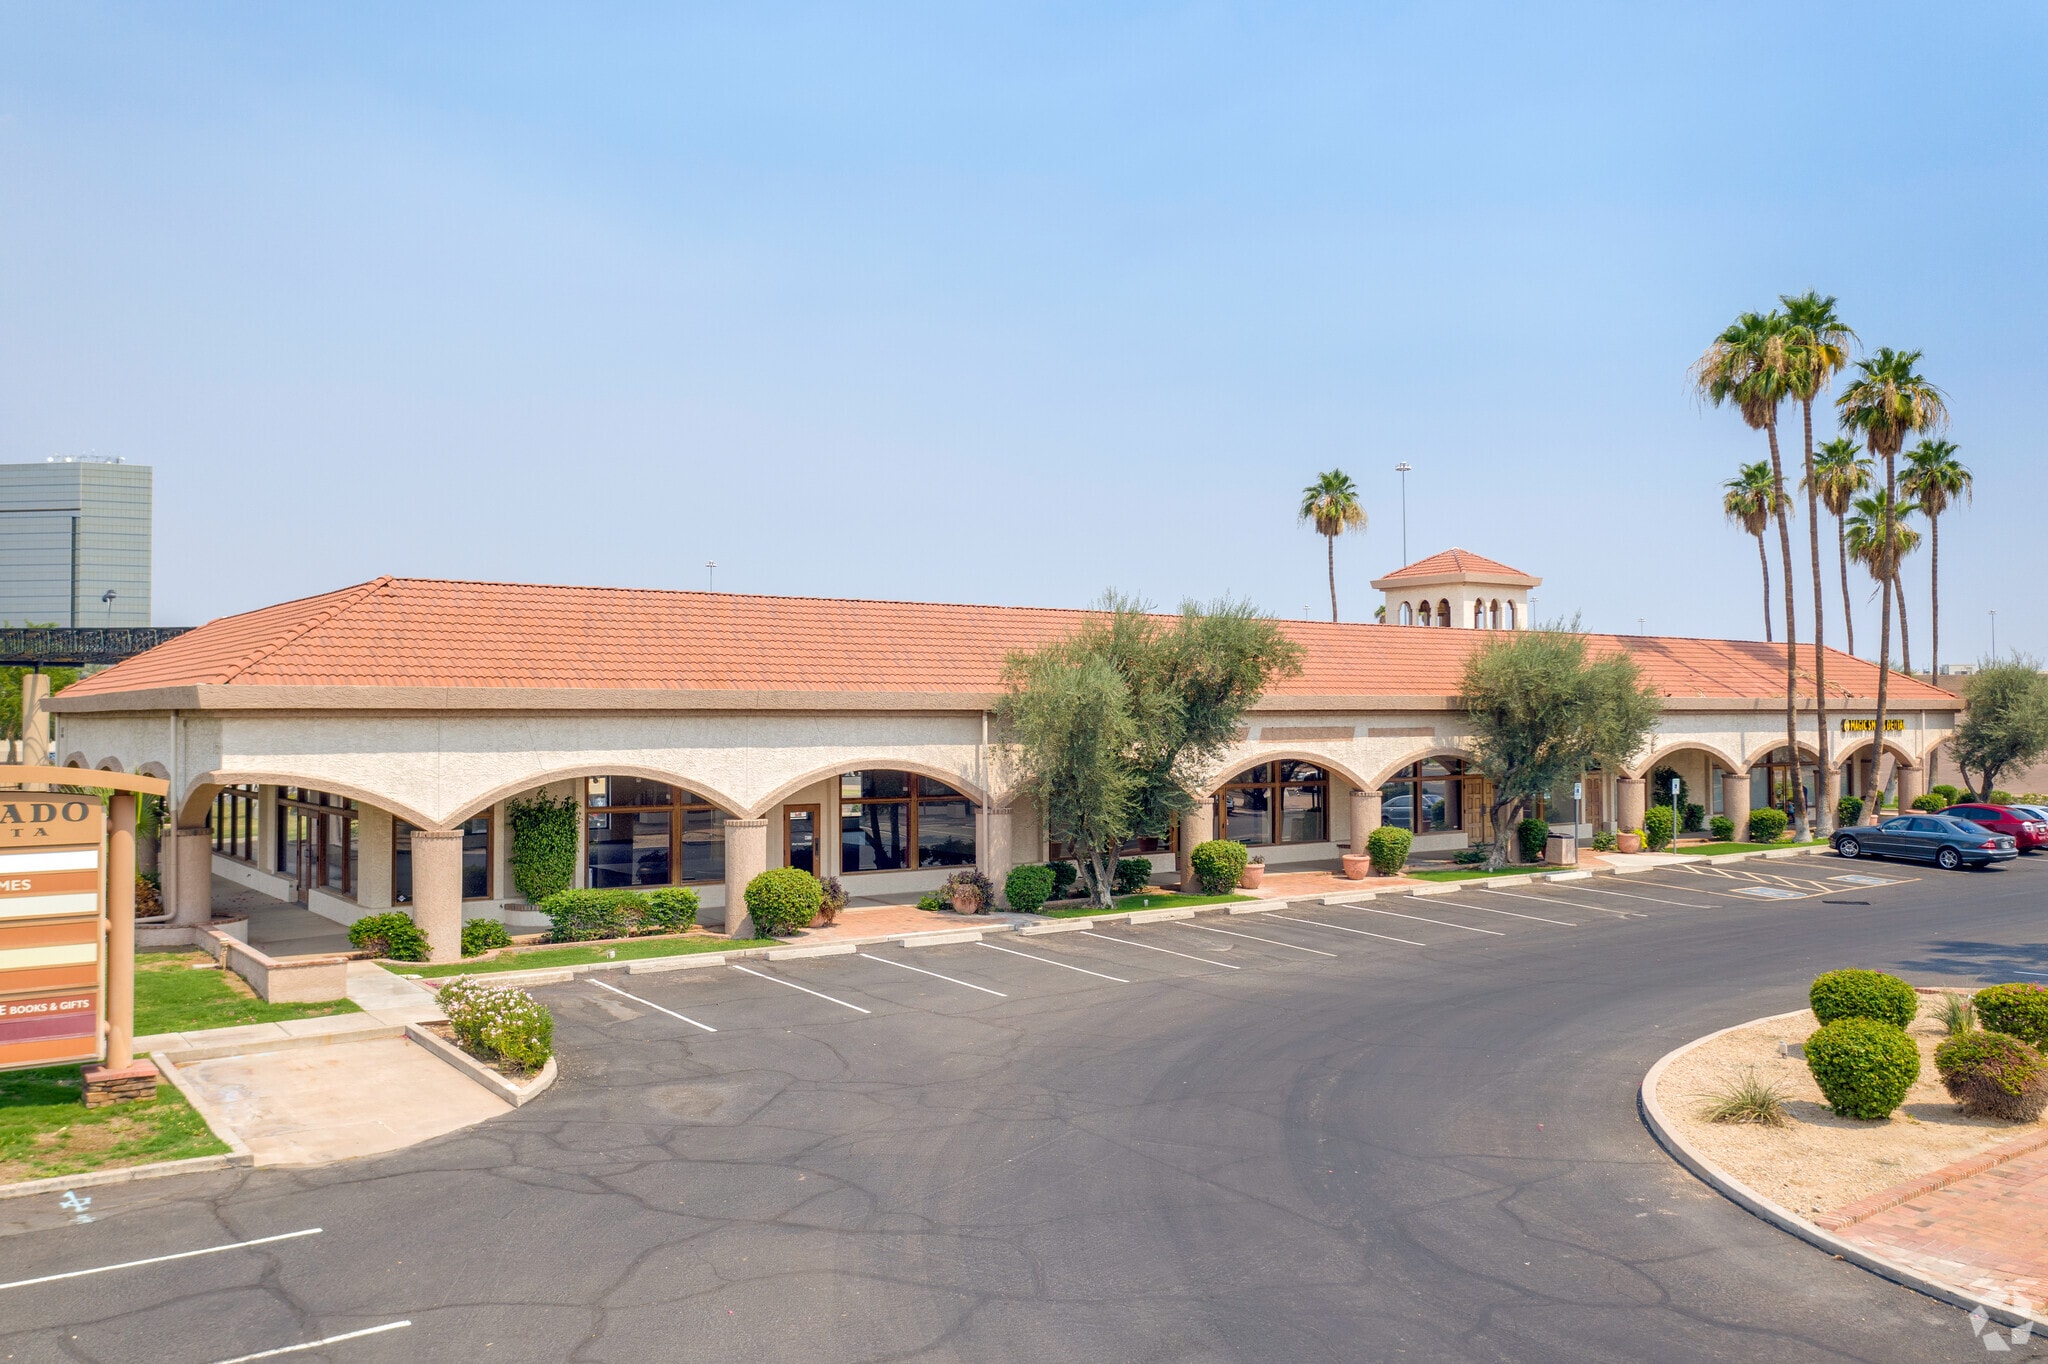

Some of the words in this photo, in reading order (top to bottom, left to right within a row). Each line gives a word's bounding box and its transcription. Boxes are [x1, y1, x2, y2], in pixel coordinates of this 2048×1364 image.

[0, 801, 90, 824] ADO
[9, 1003, 48, 1015] BOOKS
[49, 1002, 58, 1011] &
[60, 999, 90, 1010] GIFTS
